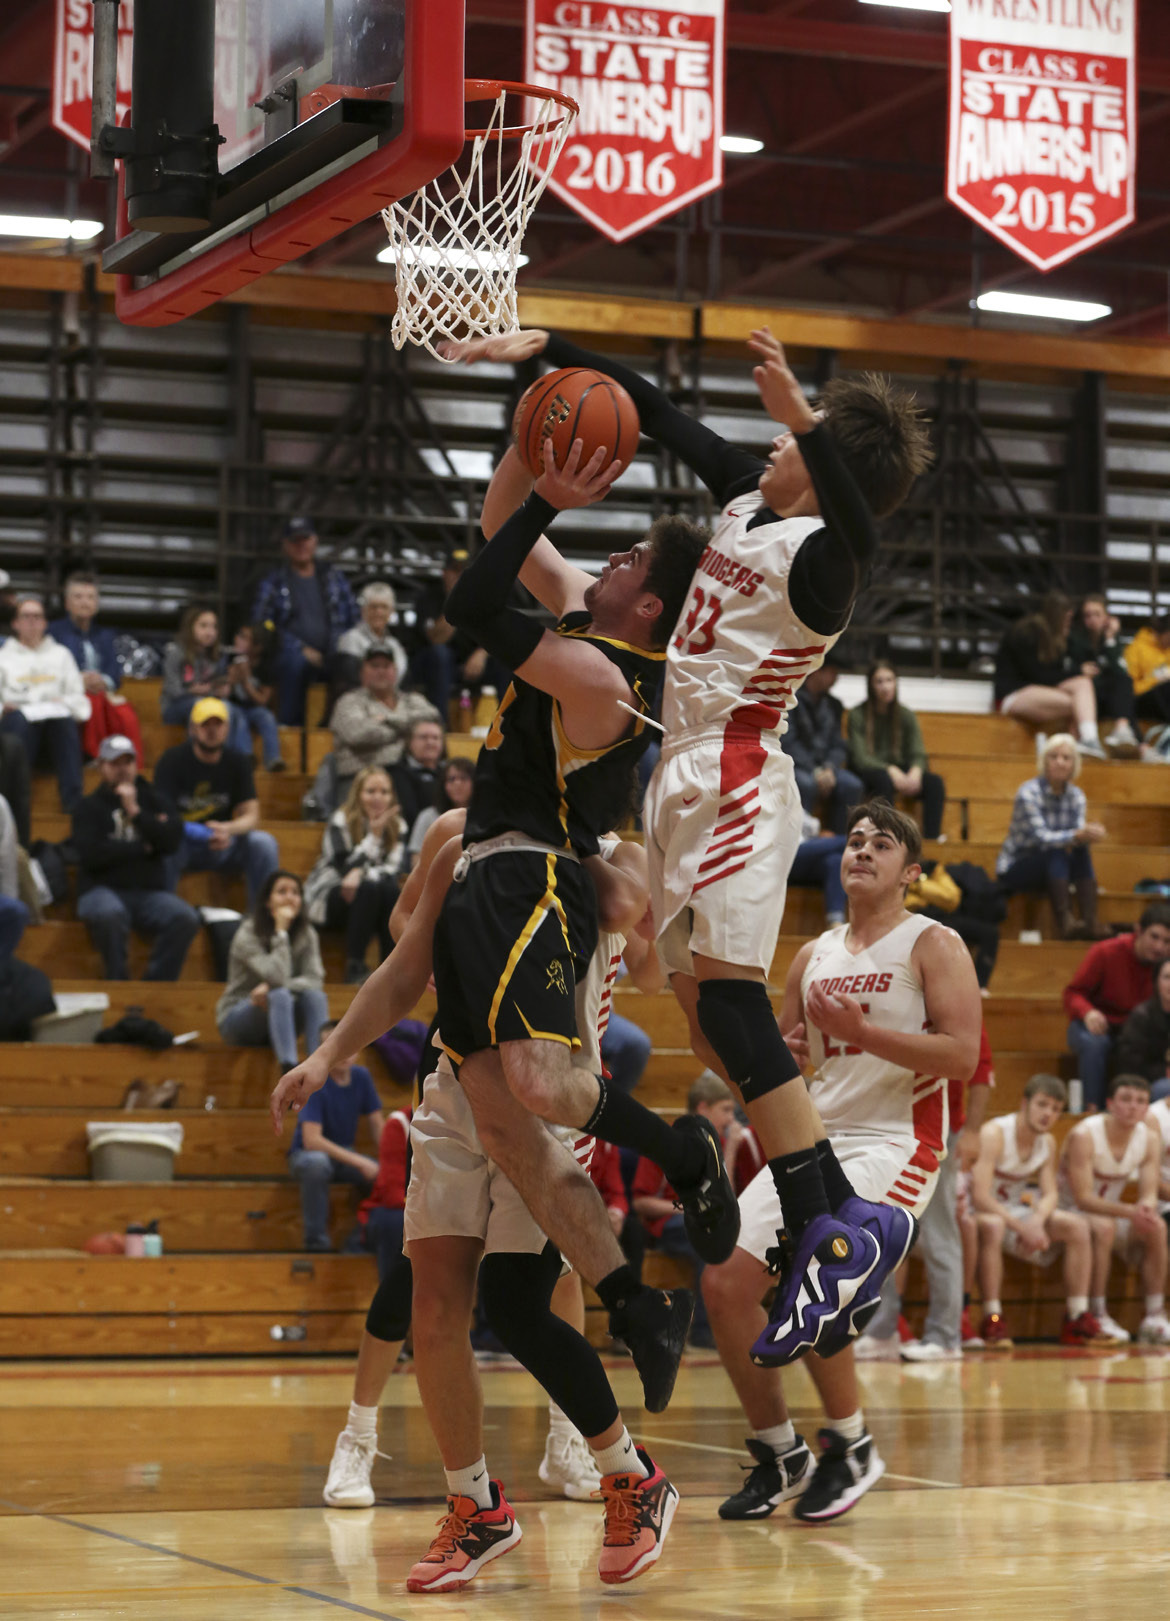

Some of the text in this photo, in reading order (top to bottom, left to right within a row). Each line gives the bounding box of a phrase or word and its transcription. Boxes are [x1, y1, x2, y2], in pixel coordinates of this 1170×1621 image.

[554, 3, 691, 39] CLASS C
[535, 36, 710, 87] STATE
[977, 48, 1107, 85] CLASS C
[962, 80, 1125, 130] STATE
[565, 144, 676, 196] 2016
[957, 112, 1128, 198] RUNNERS-UP
[991, 183, 1096, 236] 2015
